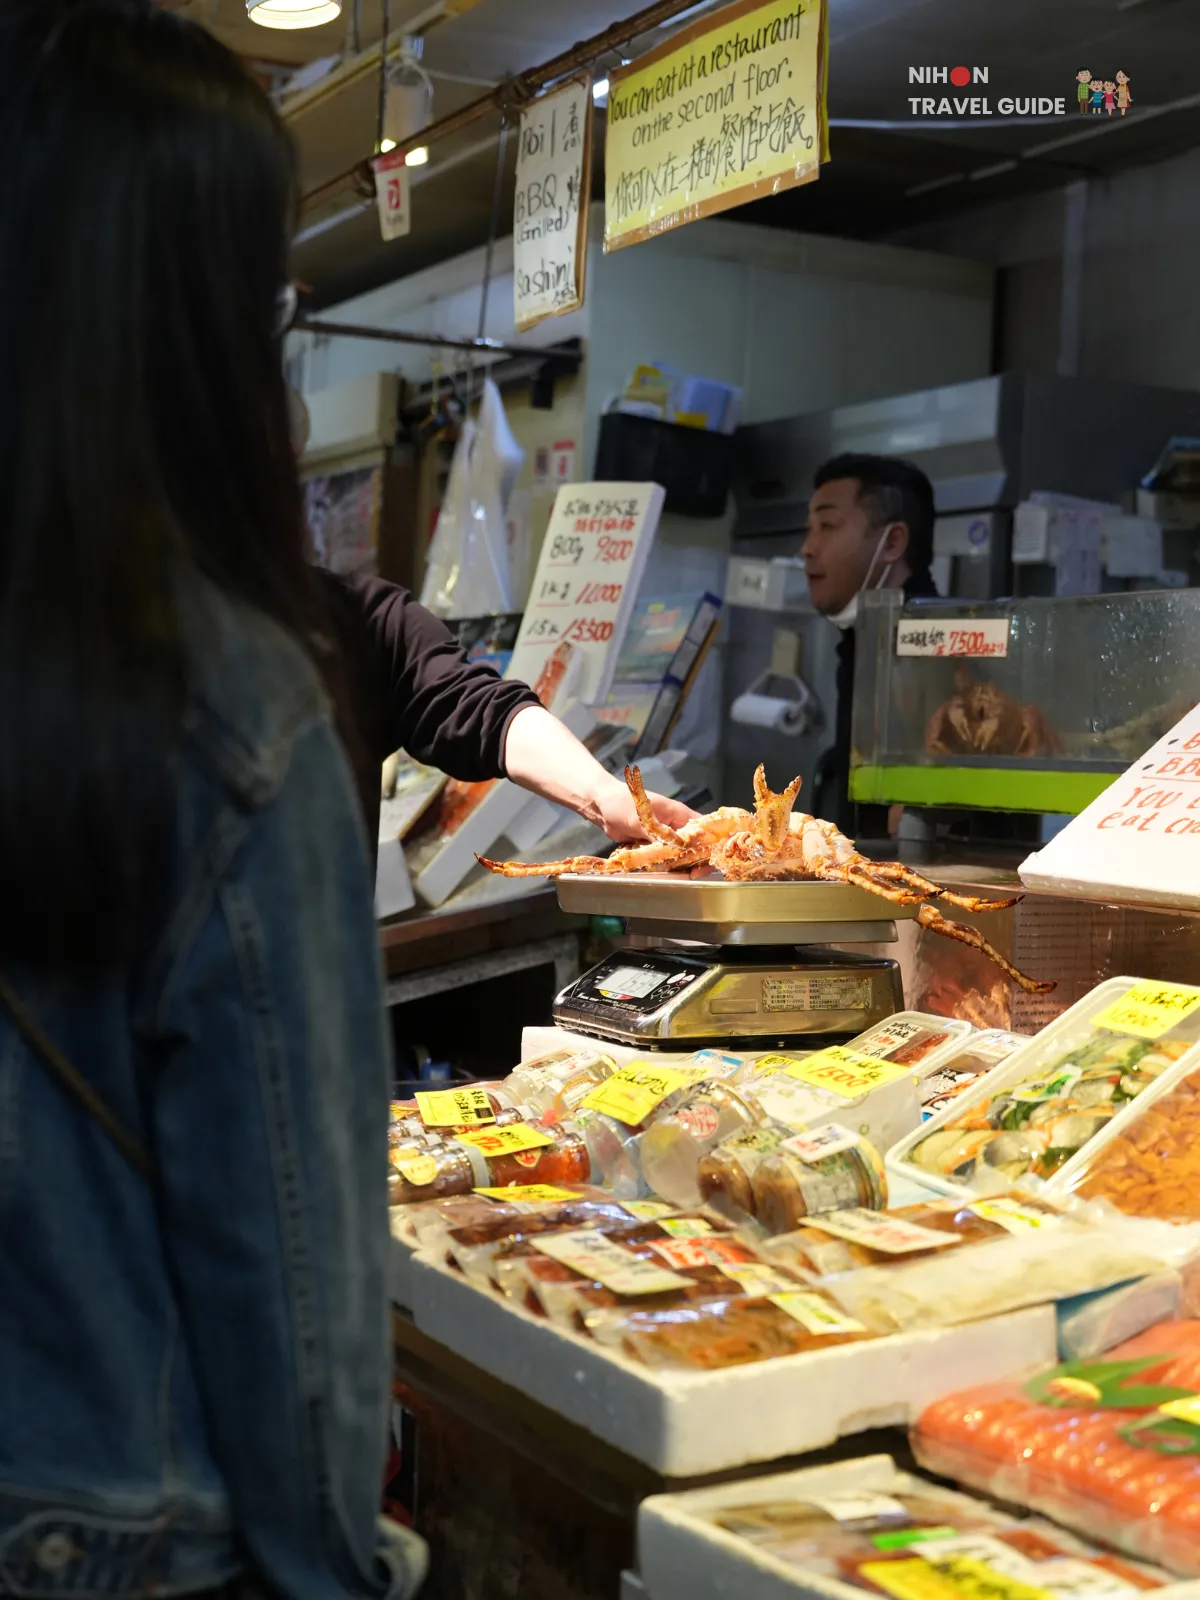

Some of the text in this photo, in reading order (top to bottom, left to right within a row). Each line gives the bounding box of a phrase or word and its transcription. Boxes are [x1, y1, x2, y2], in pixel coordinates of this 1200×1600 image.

[697, 55, 709, 79] a
[710, 4, 806, 74] restaurant
[632, 123, 653, 148] on
[652, 110, 673, 140] the
[677, 71, 736, 129] second
[516, 173, 558, 223] BBQ
[1097, 812, 1160, 831] eat
